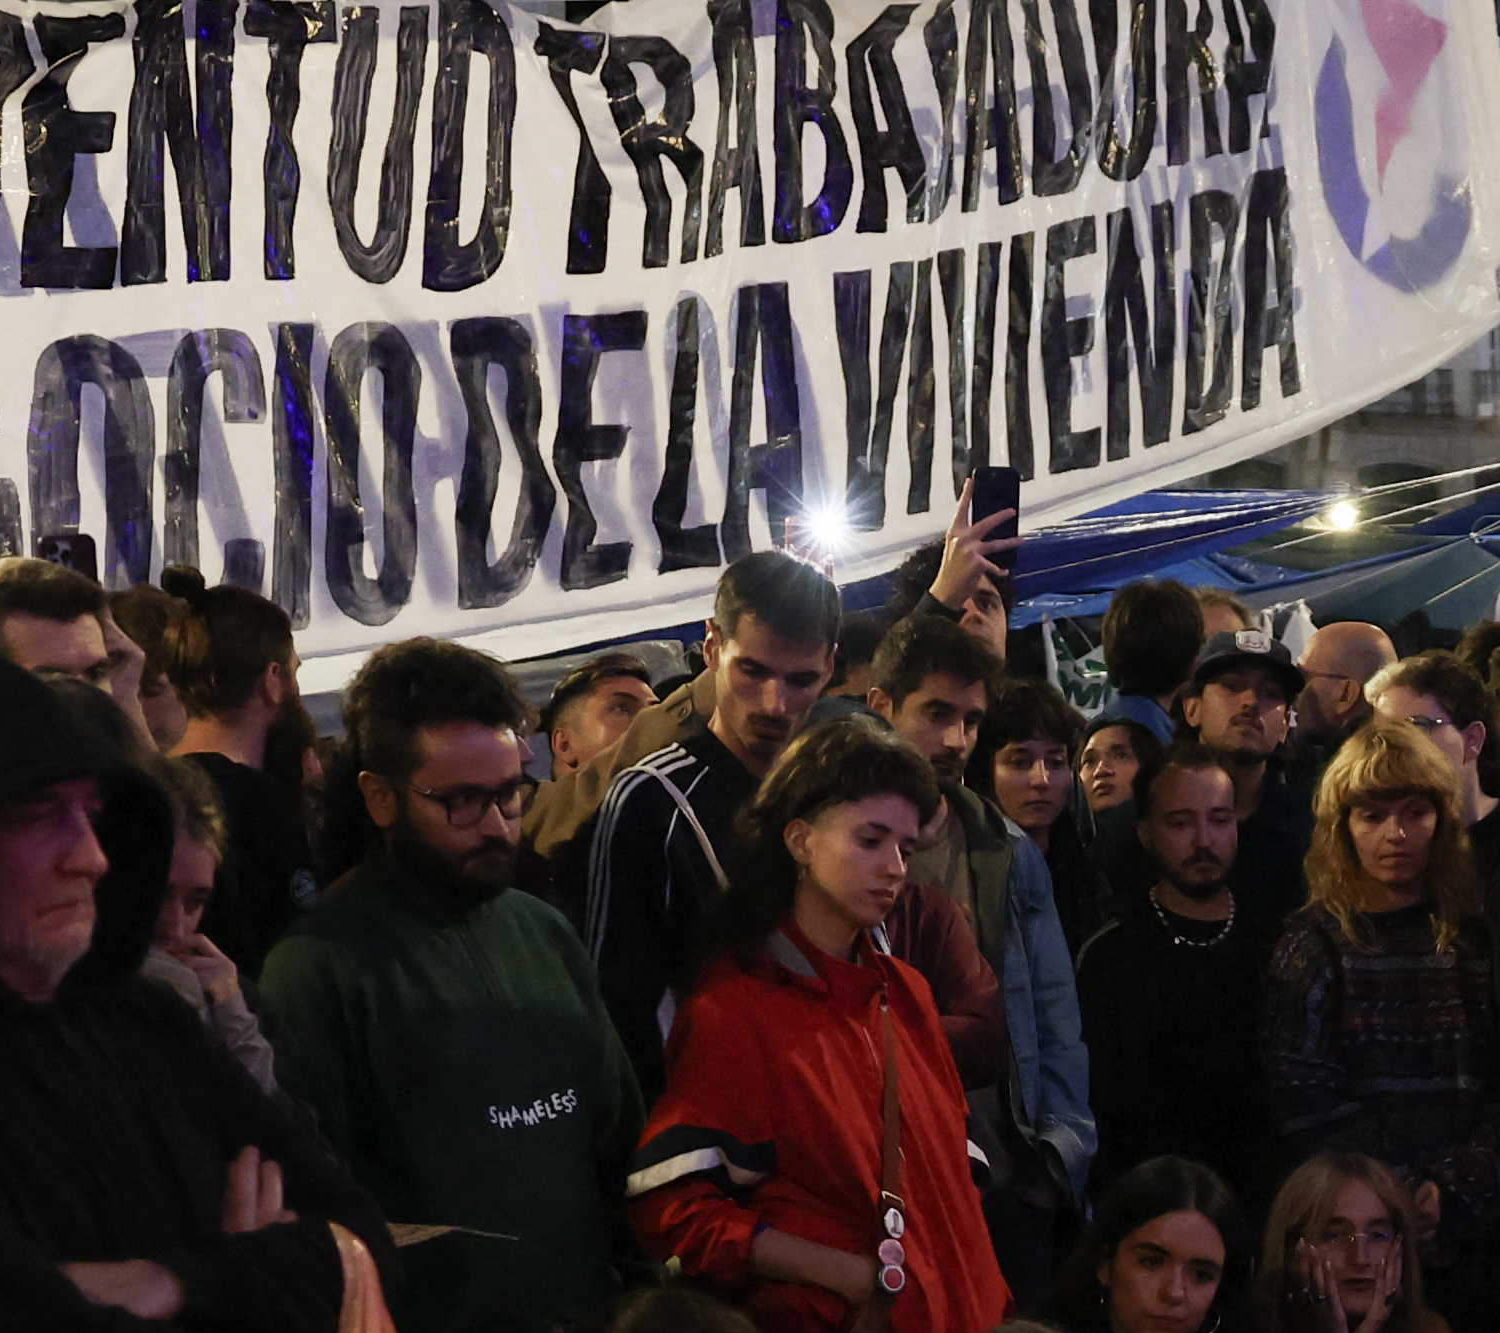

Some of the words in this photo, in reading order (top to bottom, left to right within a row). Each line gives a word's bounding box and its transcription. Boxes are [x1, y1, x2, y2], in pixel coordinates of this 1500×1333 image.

[535, 0, 1278, 275] TRABAJADORA
[447, 310, 650, 608] DE
[652, 280, 802, 572] LA
[835, 168, 1302, 532] VIVIENDA
[487, 1087, 579, 1130] SHAMELESS
